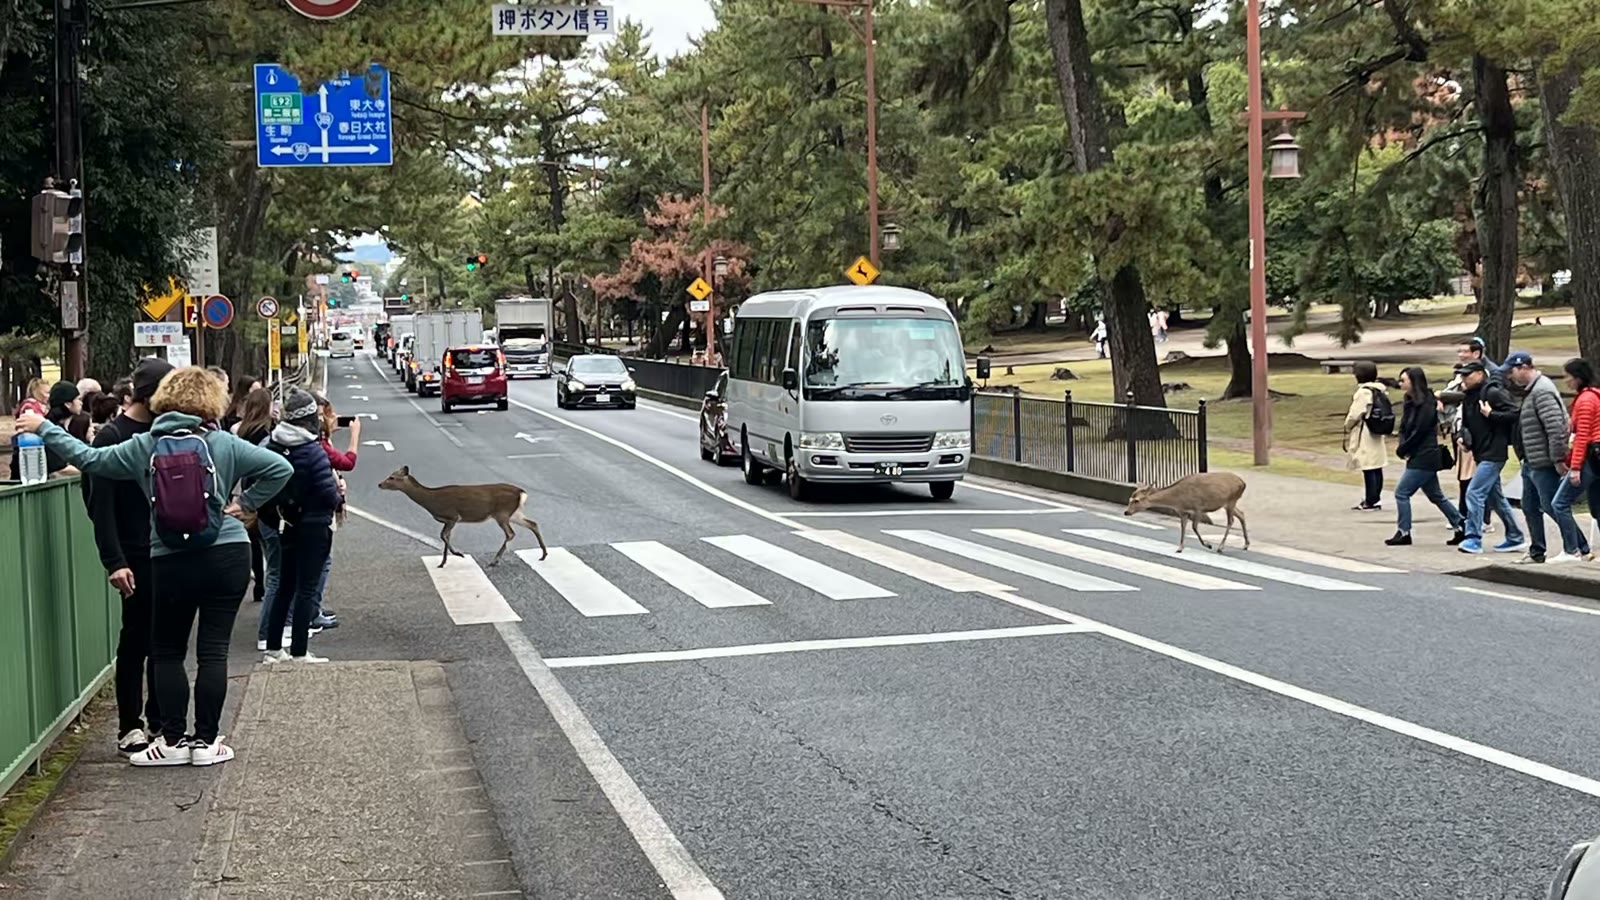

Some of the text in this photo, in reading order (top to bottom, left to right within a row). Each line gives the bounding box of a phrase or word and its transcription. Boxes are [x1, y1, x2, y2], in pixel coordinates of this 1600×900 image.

[498, 9, 609, 32] 押ボタン信号
[350, 99, 386, 111] 東大寺
[338, 121, 386, 133] 春日大社
